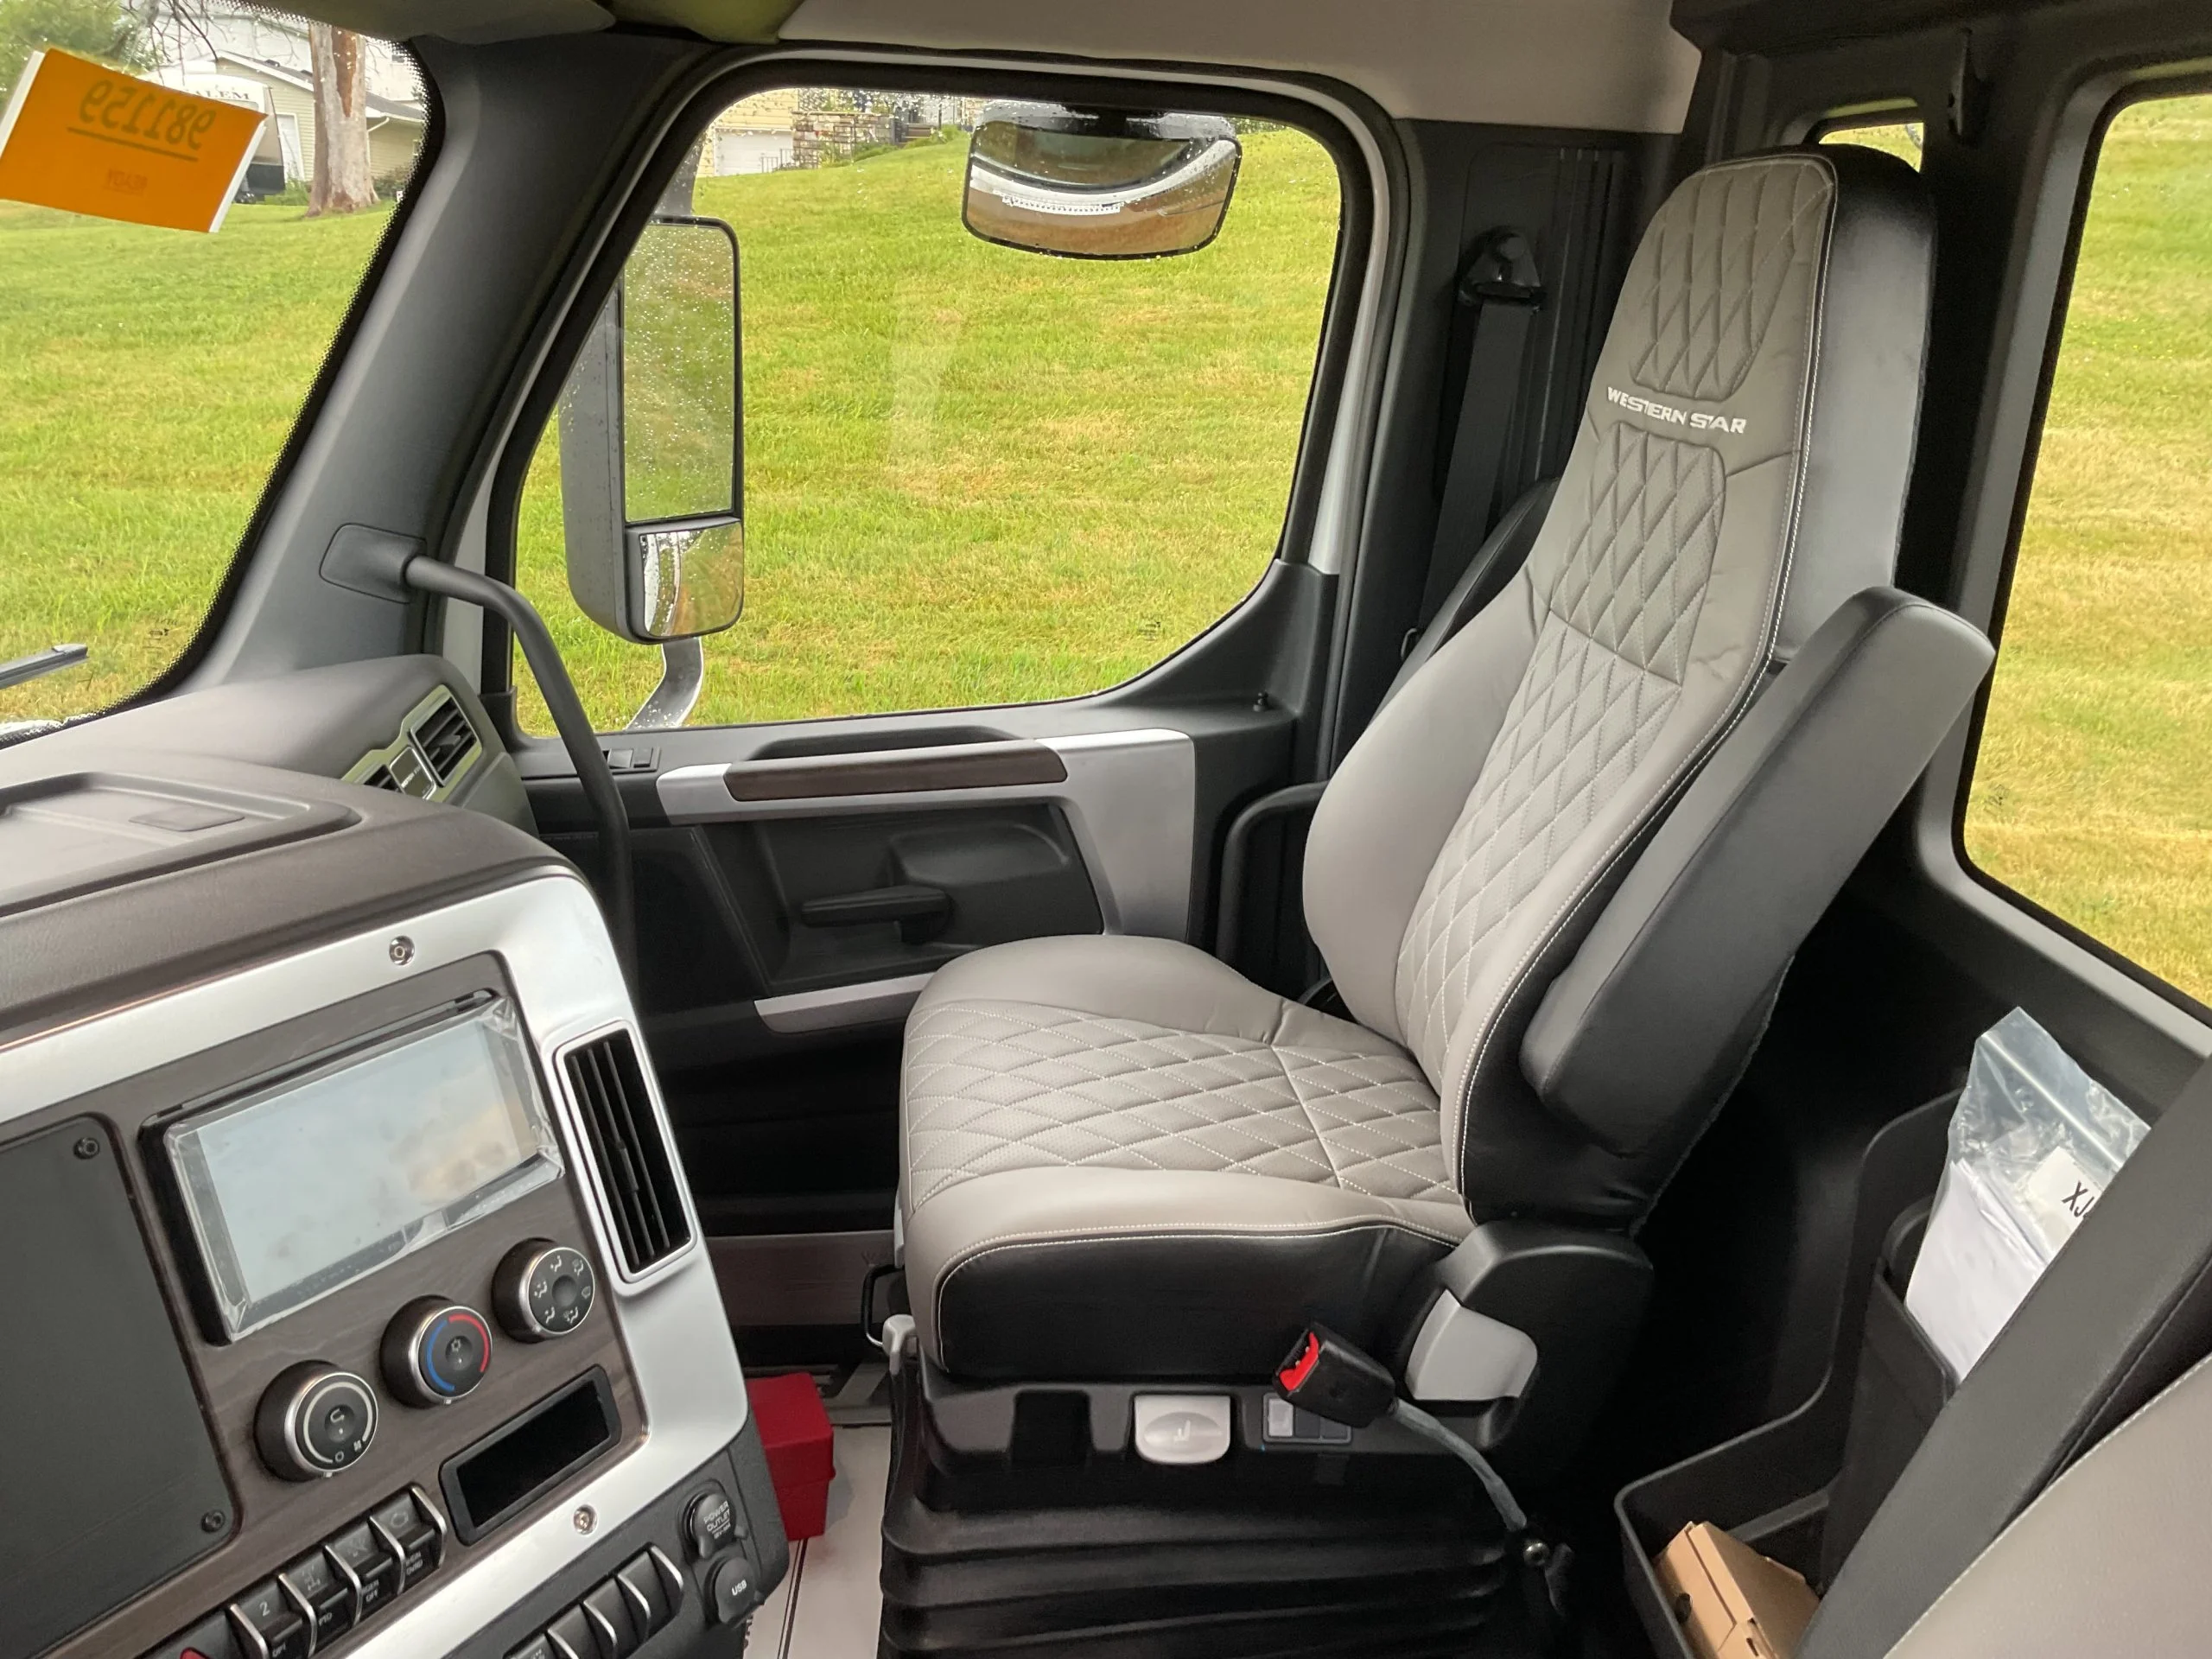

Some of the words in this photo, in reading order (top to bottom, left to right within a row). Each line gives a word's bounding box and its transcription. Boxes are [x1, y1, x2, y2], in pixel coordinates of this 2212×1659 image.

[181, 89, 251, 100] ALEM
[1607, 386, 1687, 426] WESTERN
[1689, 411, 1747, 434] STAR
[703, 1500, 729, 1524] POWER
[706, 1509, 730, 1532] OUTLET
[731, 1580, 747, 1596] USB
[259, 1601, 270, 1618] 2
